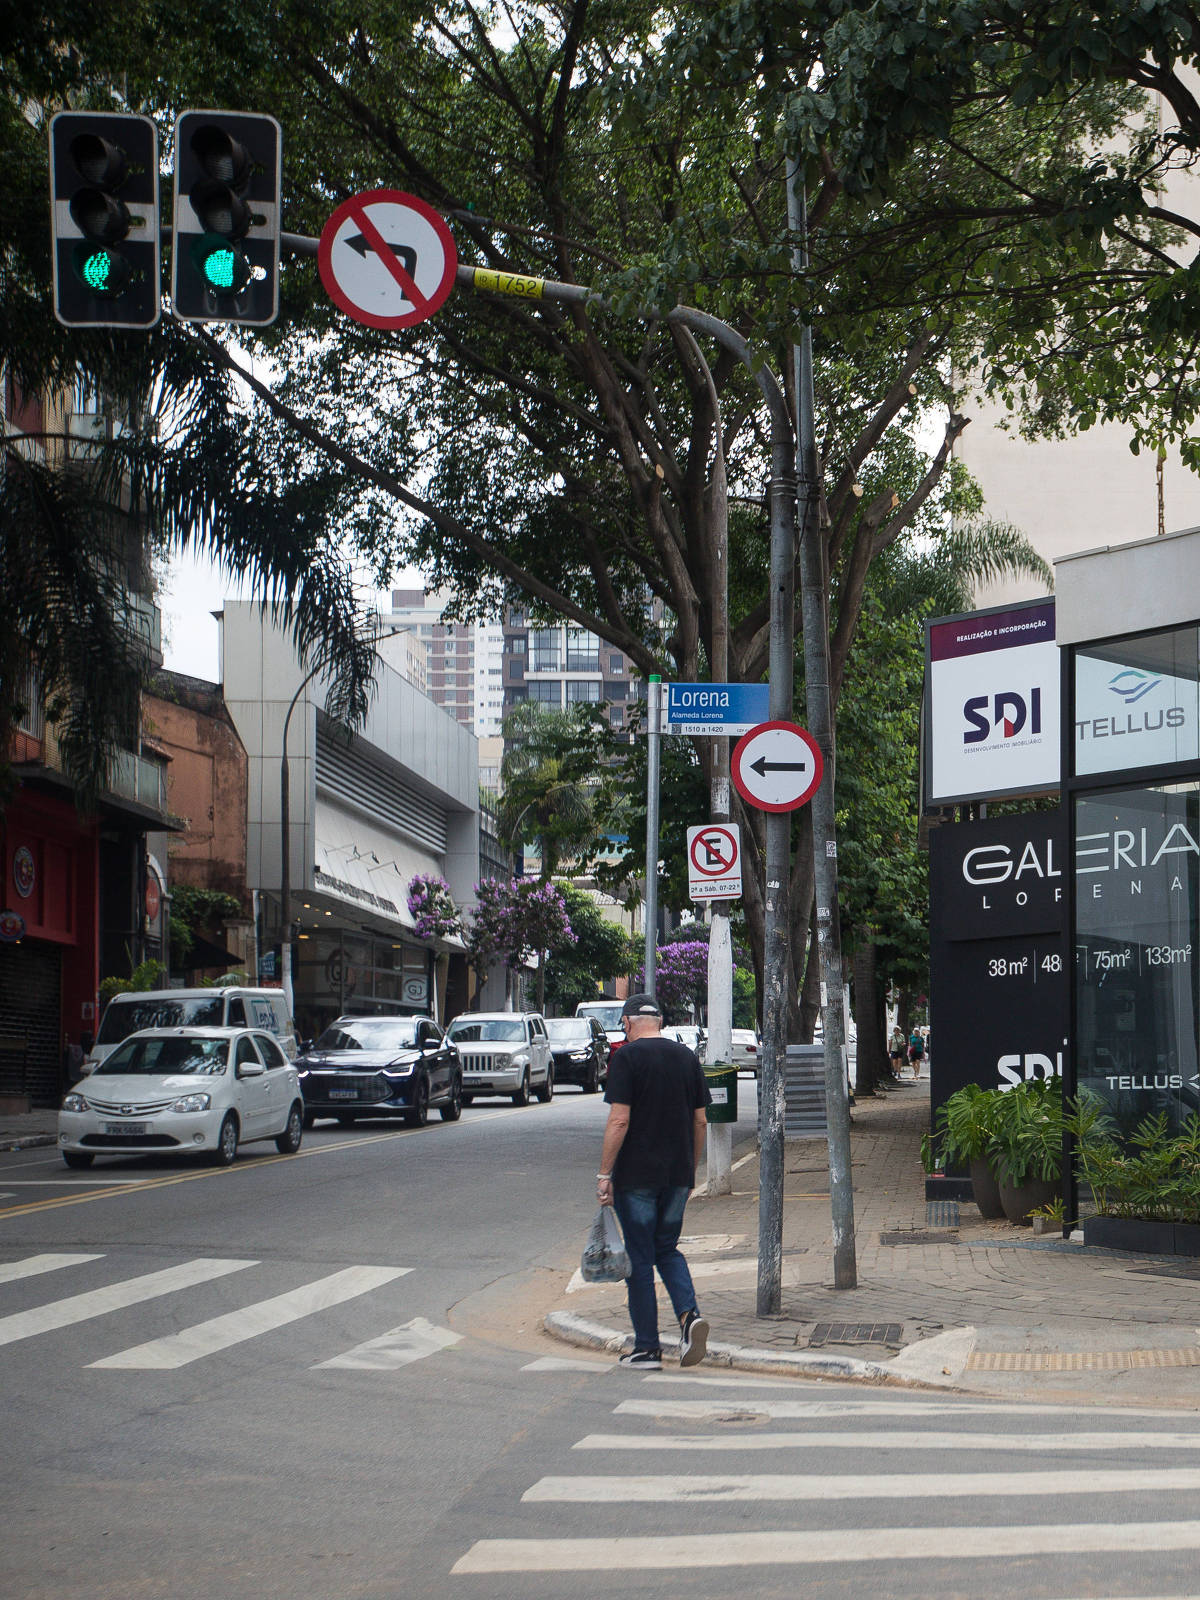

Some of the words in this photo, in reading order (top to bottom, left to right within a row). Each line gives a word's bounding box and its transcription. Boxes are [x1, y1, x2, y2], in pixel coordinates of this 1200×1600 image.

[494, 274, 537, 295] 1752
[956, 629, 992, 642] REALIZAÇÃO
[999, 619, 1047, 635] INCORPORAÇÃO
[671, 688, 729, 707] Lorena
[963, 687, 1041, 744] SDI
[1075, 706, 1185, 740] TELLUS
[964, 743, 1010, 754] DESENVOLVIMENTO
[1012, 738, 1042, 747] IMOBILIÁRIO
[1093, 949, 1131, 969] 75m²
[1145, 944, 1192, 966] 133m²
[1105, 1075, 1183, 1090] TELLUS
